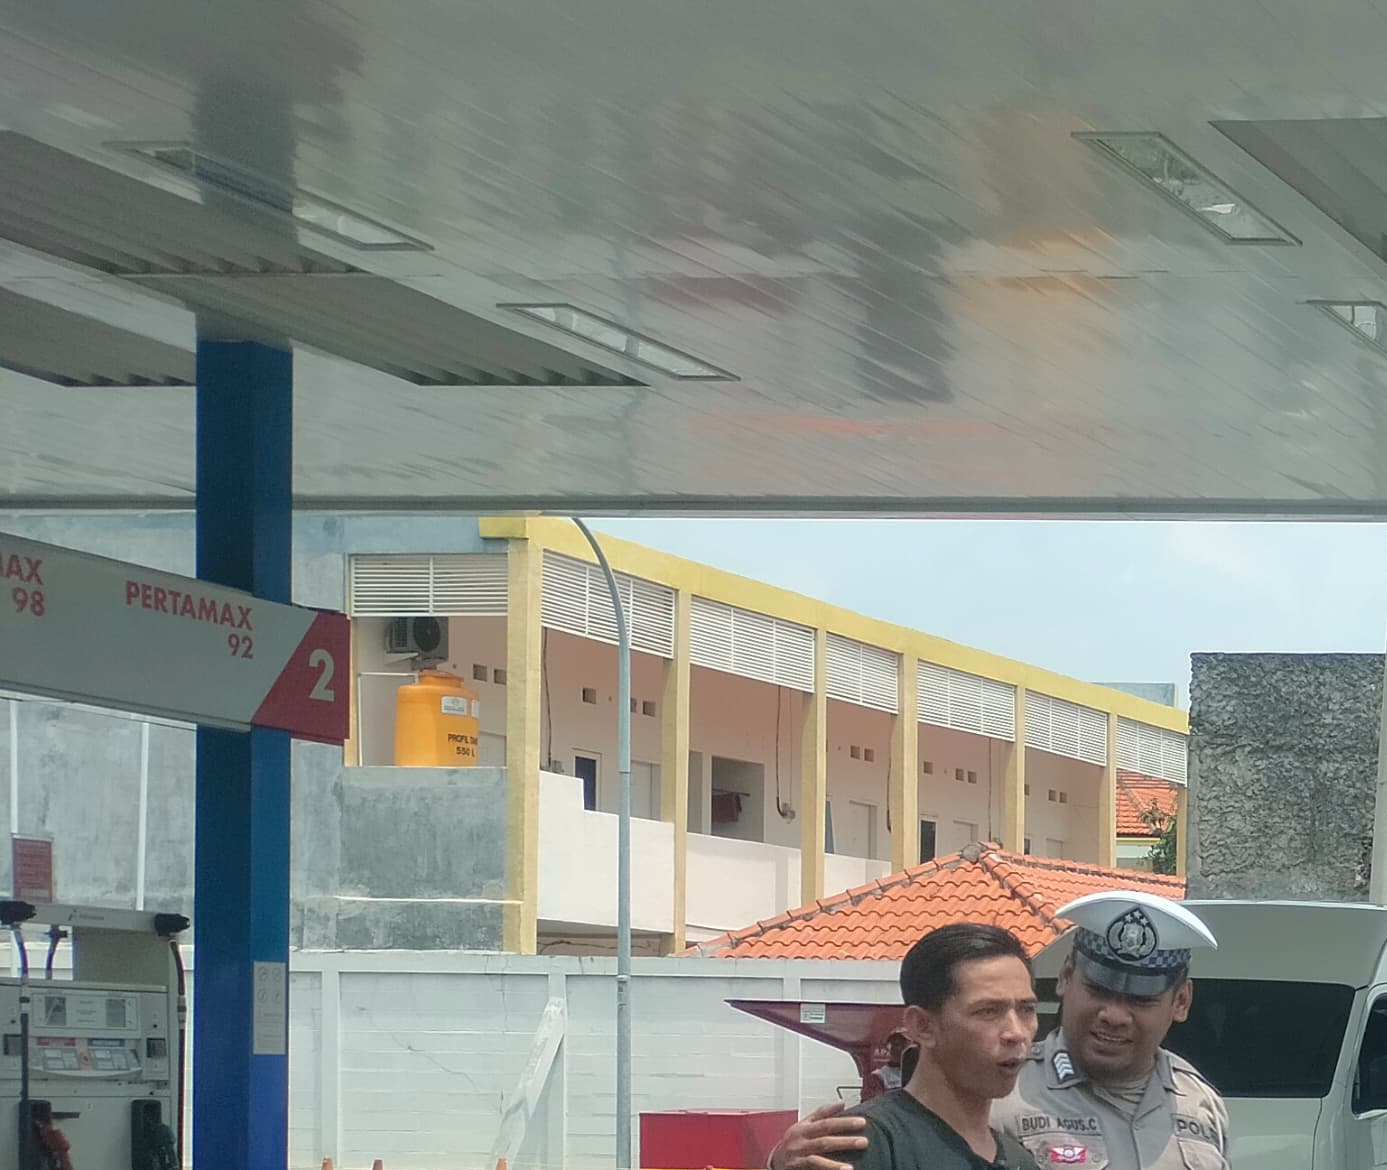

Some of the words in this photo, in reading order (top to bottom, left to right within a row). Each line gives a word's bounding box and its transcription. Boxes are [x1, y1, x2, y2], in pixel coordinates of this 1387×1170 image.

[0, 552, 44, 586] AX
[11, 587, 46, 617] 98
[125, 580, 254, 632] PERTAMAX
[227, 633, 254, 660] 92
[308, 648, 336, 702] 2
[1022, 1117, 1050, 1132] BUDI
